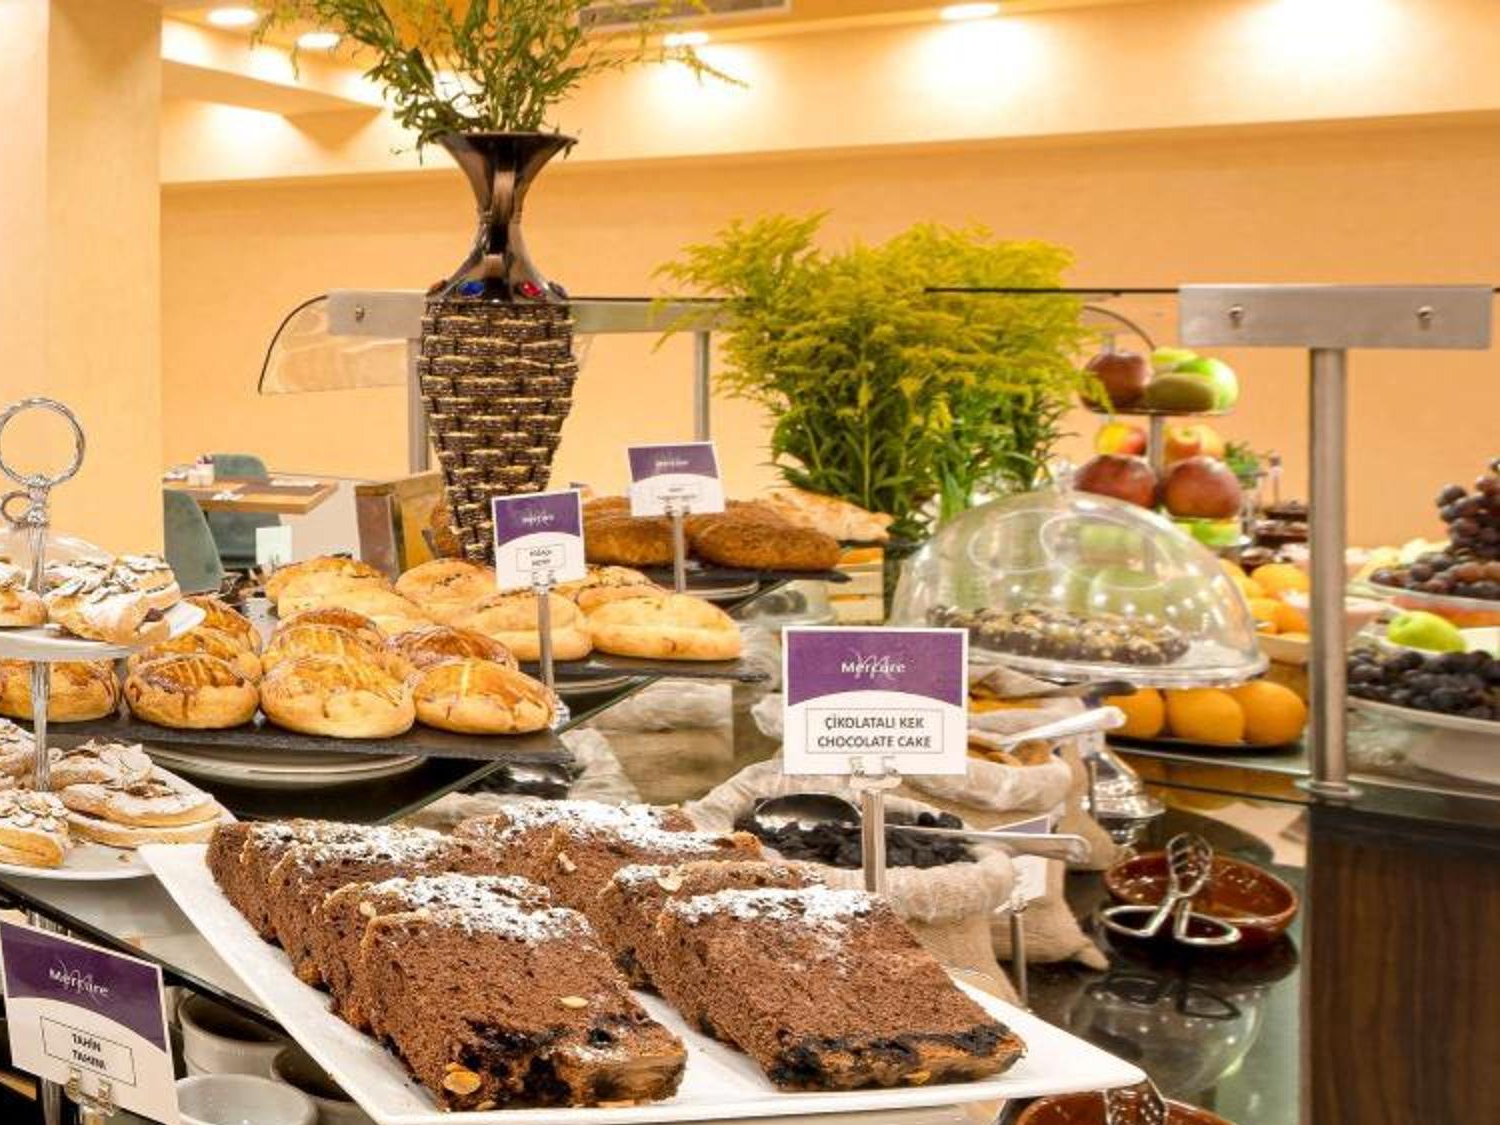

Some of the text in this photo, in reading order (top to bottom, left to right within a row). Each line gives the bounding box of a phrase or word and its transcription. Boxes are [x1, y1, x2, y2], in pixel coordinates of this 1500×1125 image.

[841, 660, 906, 674] Mercure
[824, 713, 925, 731] ÇİKOLATALI KEK
[817, 735, 931, 748] CHOCOLATE CAKE
[49, 966, 110, 998] Mercure
